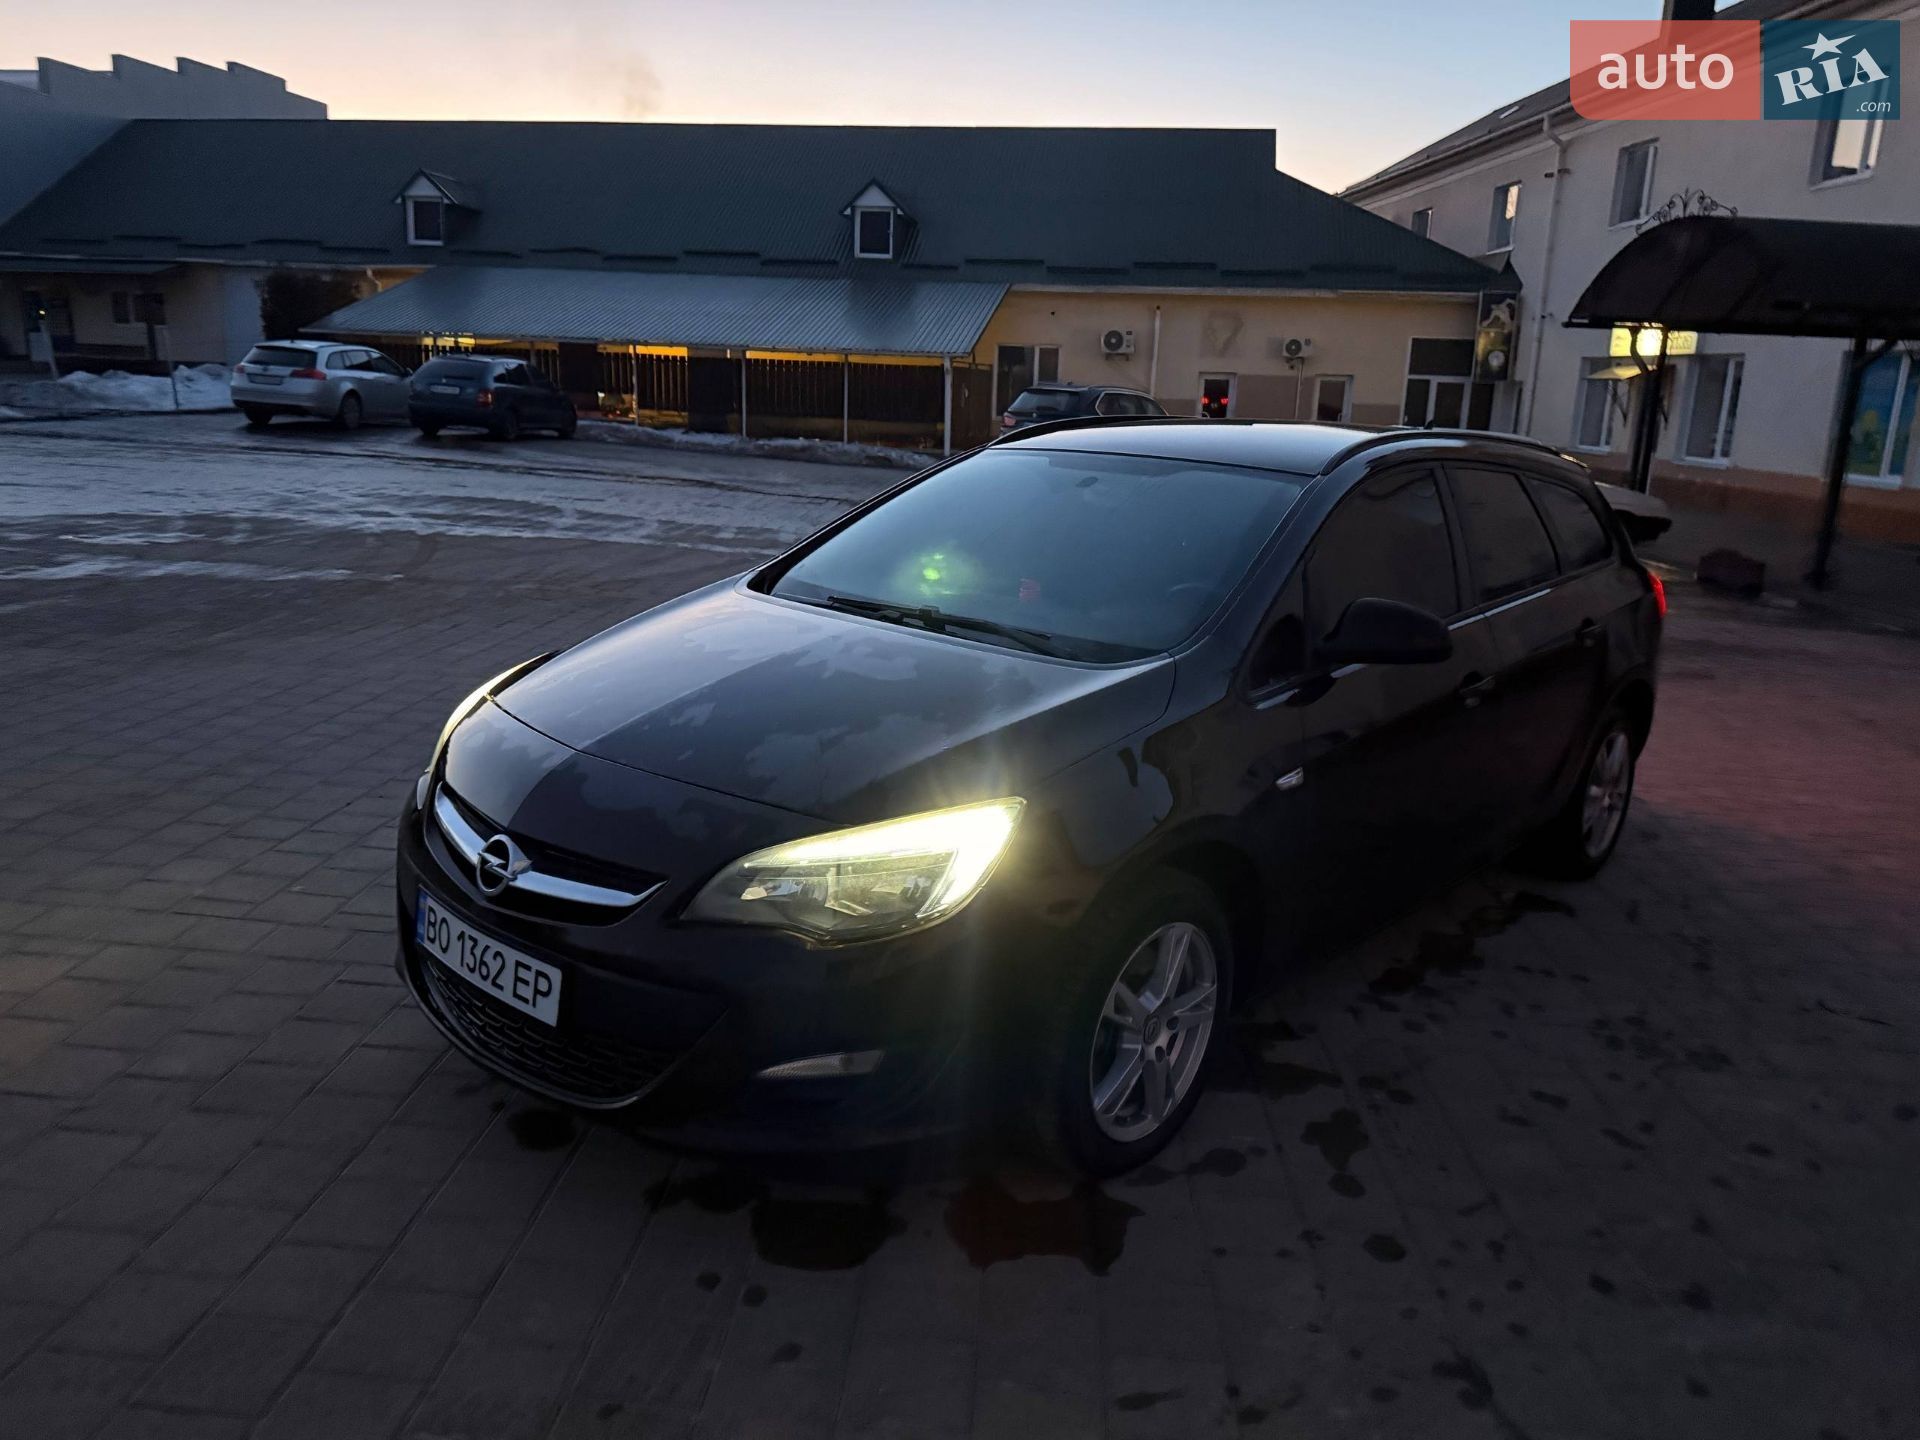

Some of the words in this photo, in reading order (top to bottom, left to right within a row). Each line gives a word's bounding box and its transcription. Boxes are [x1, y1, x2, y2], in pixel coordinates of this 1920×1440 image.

[426, 904, 450, 954] BO
[457, 930, 506, 992] 1362
[512, 959, 552, 1008] EP
